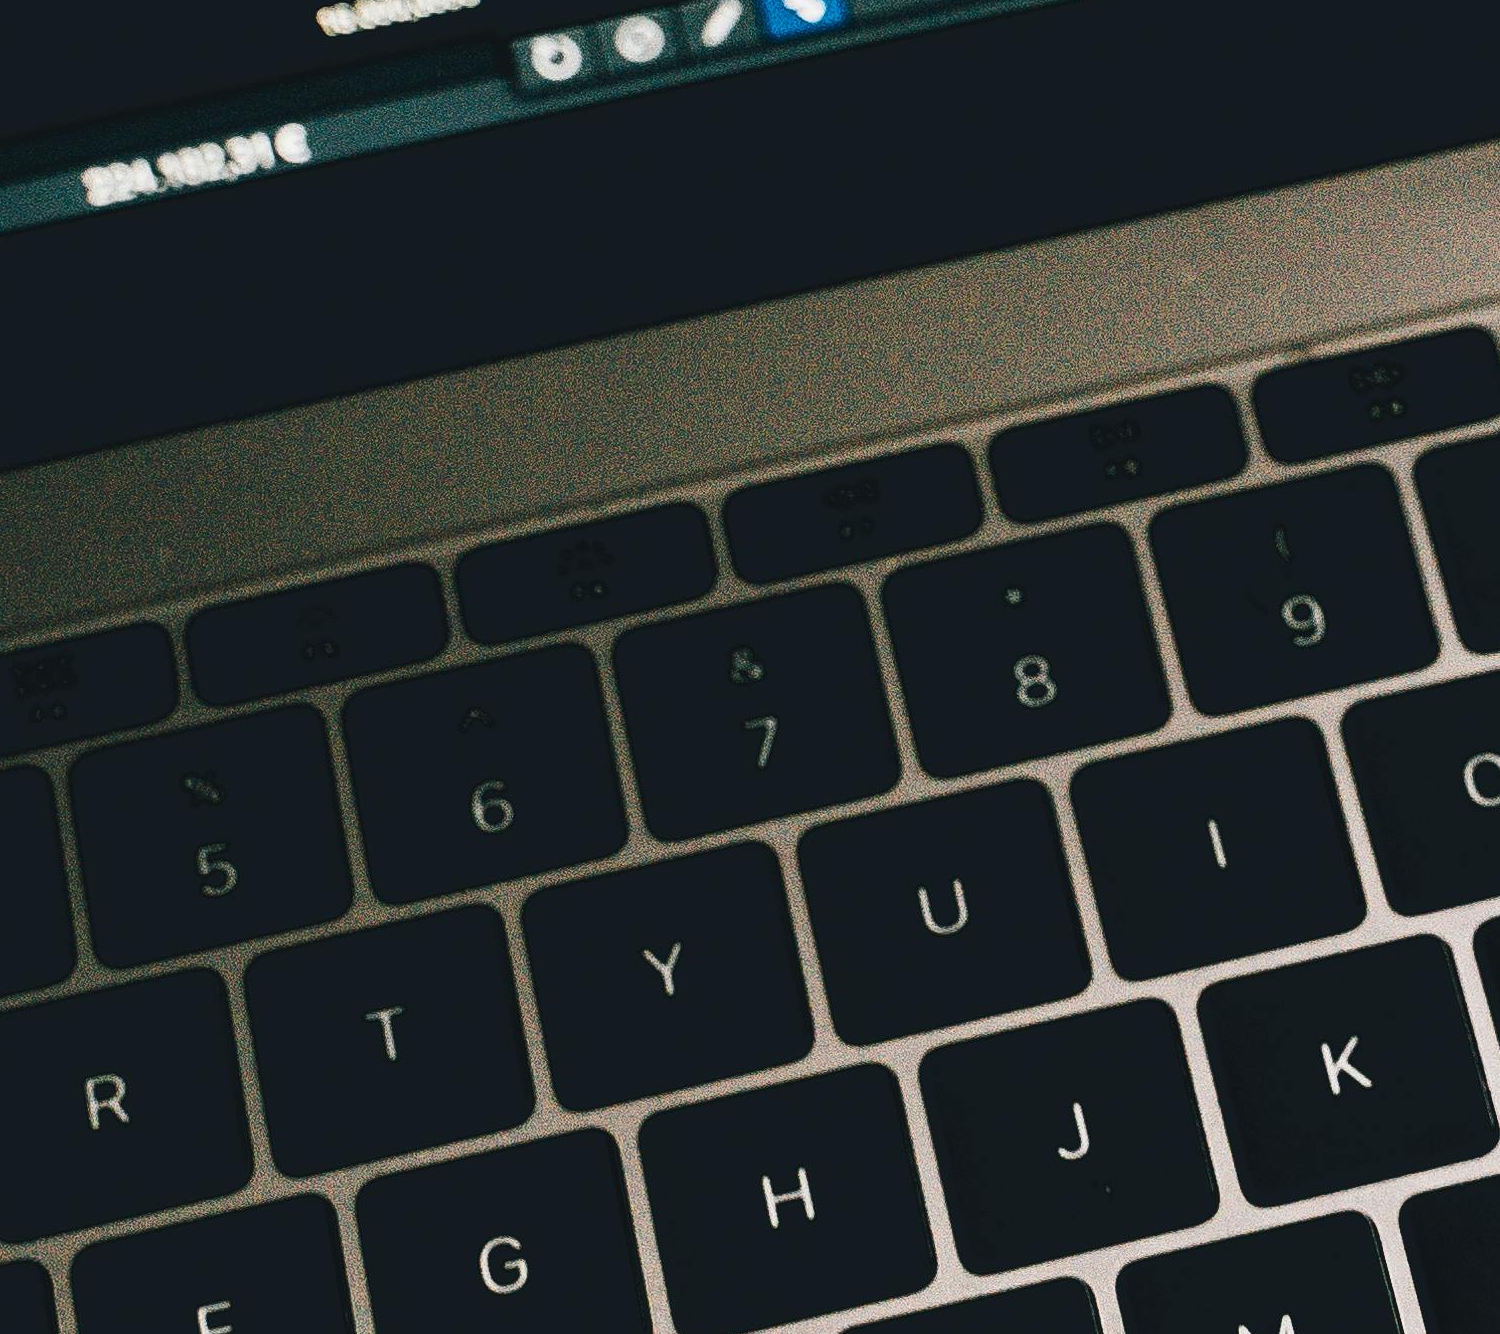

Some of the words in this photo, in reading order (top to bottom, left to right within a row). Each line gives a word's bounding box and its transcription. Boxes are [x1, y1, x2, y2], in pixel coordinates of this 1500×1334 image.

[1279, 592, 1327, 648] 9
[1014, 657, 1056, 707] 8
[741, 715, 780, 770] 7
[470, 779, 515, 834] 6
[194, 842, 239, 898] 5
[918, 880, 968, 934] U
[644, 944, 681, 995] Y
[365, 1006, 404, 1061] T
[1320, 1036, 1372, 1095] K
[85, 1075, 129, 1129] R
[1058, 1102, 1090, 1160] J
[762, 1168, 815, 1228] H
[479, 1236, 529, 1294] G
